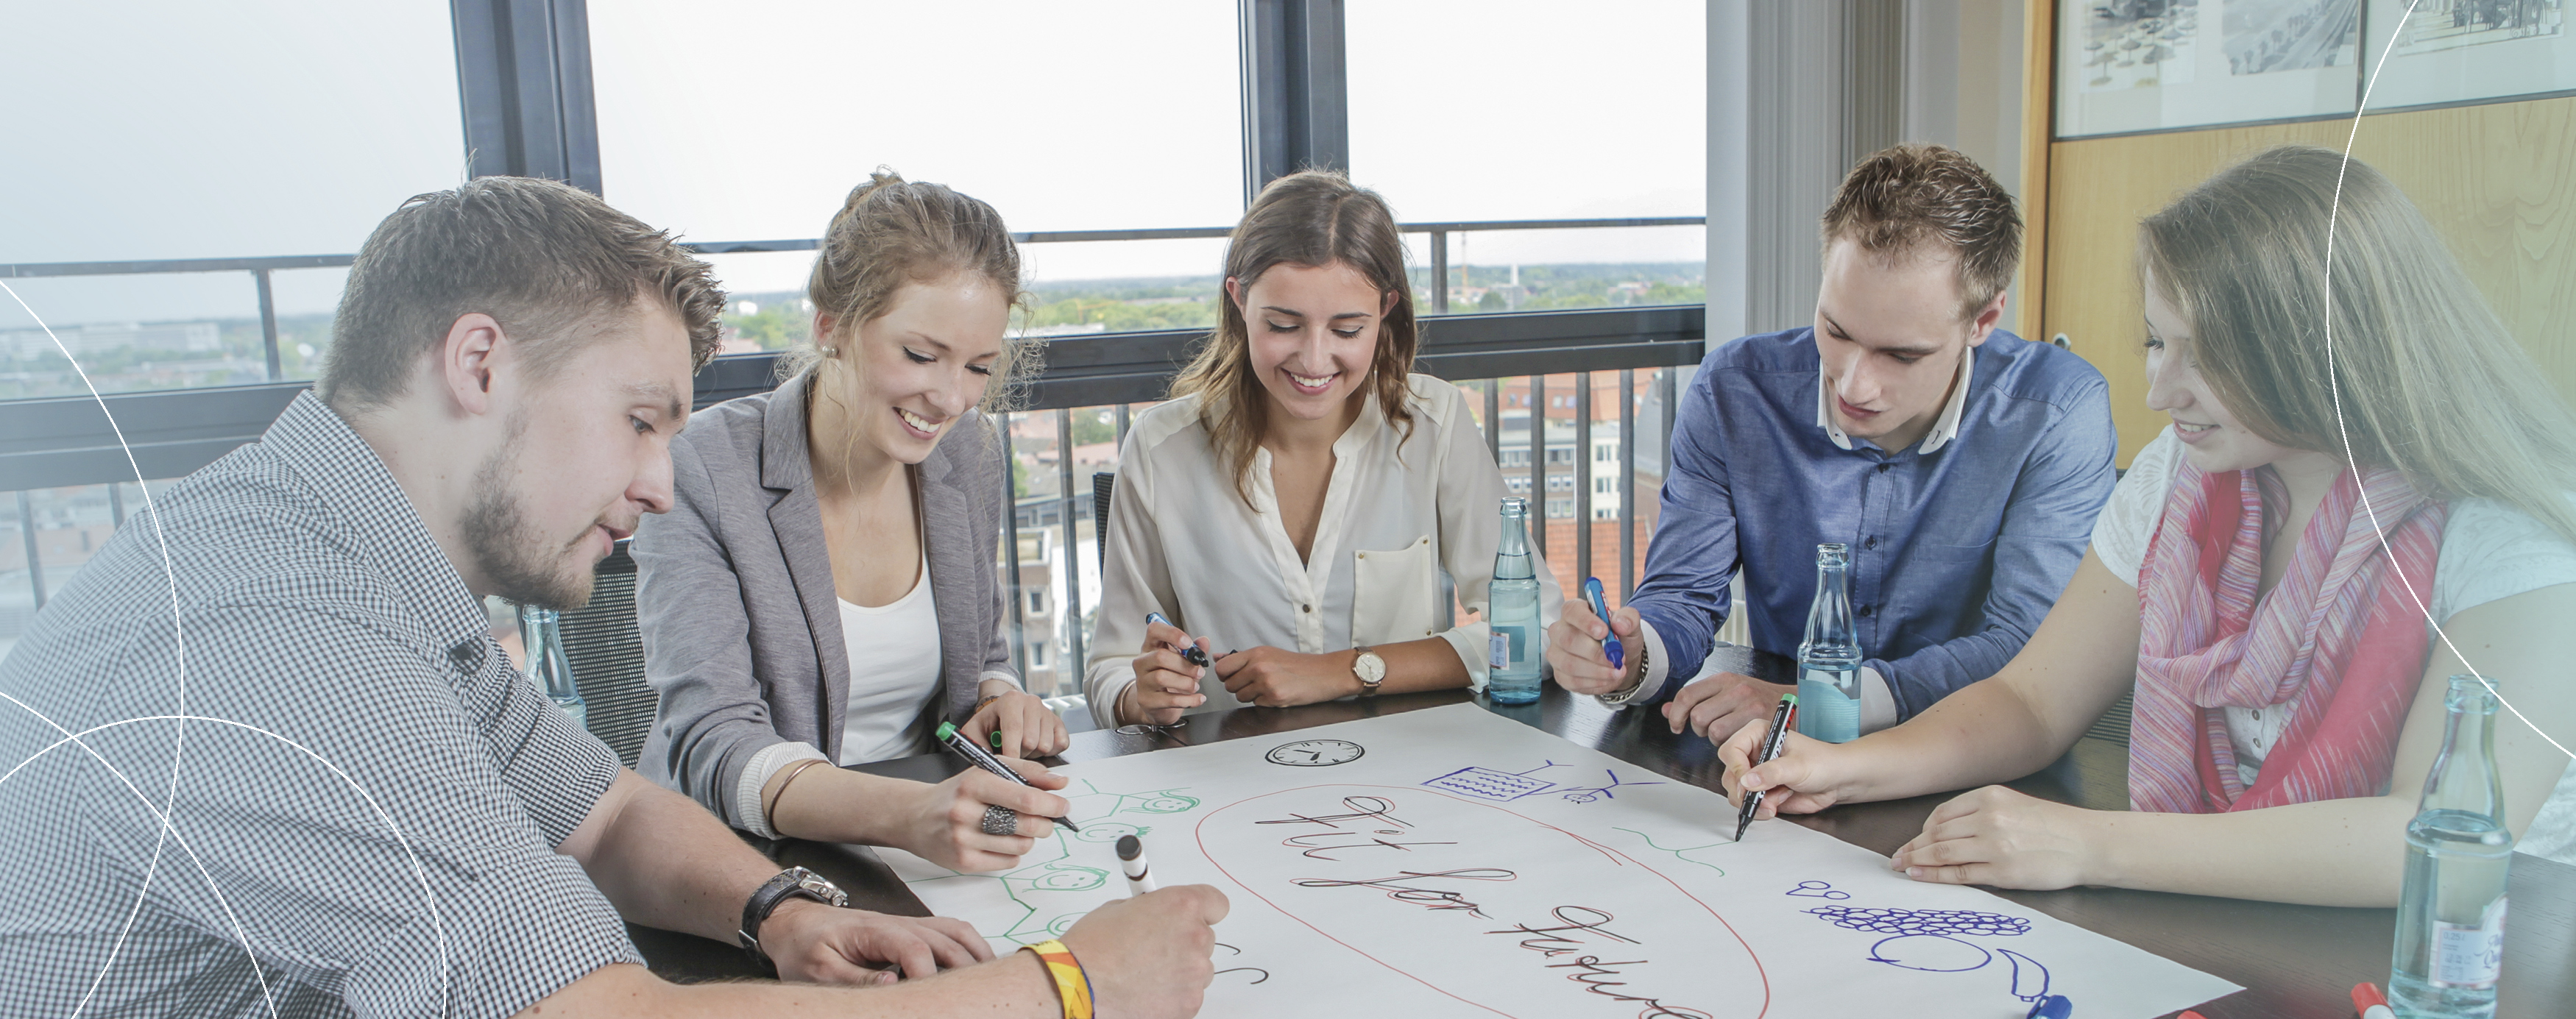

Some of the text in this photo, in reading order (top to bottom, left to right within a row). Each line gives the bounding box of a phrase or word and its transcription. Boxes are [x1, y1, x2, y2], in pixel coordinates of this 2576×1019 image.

[1254, 795, 1458, 862] Fit
[1289, 867, 1517, 920] for
[2443, 931, 2460, 941] 0,25
